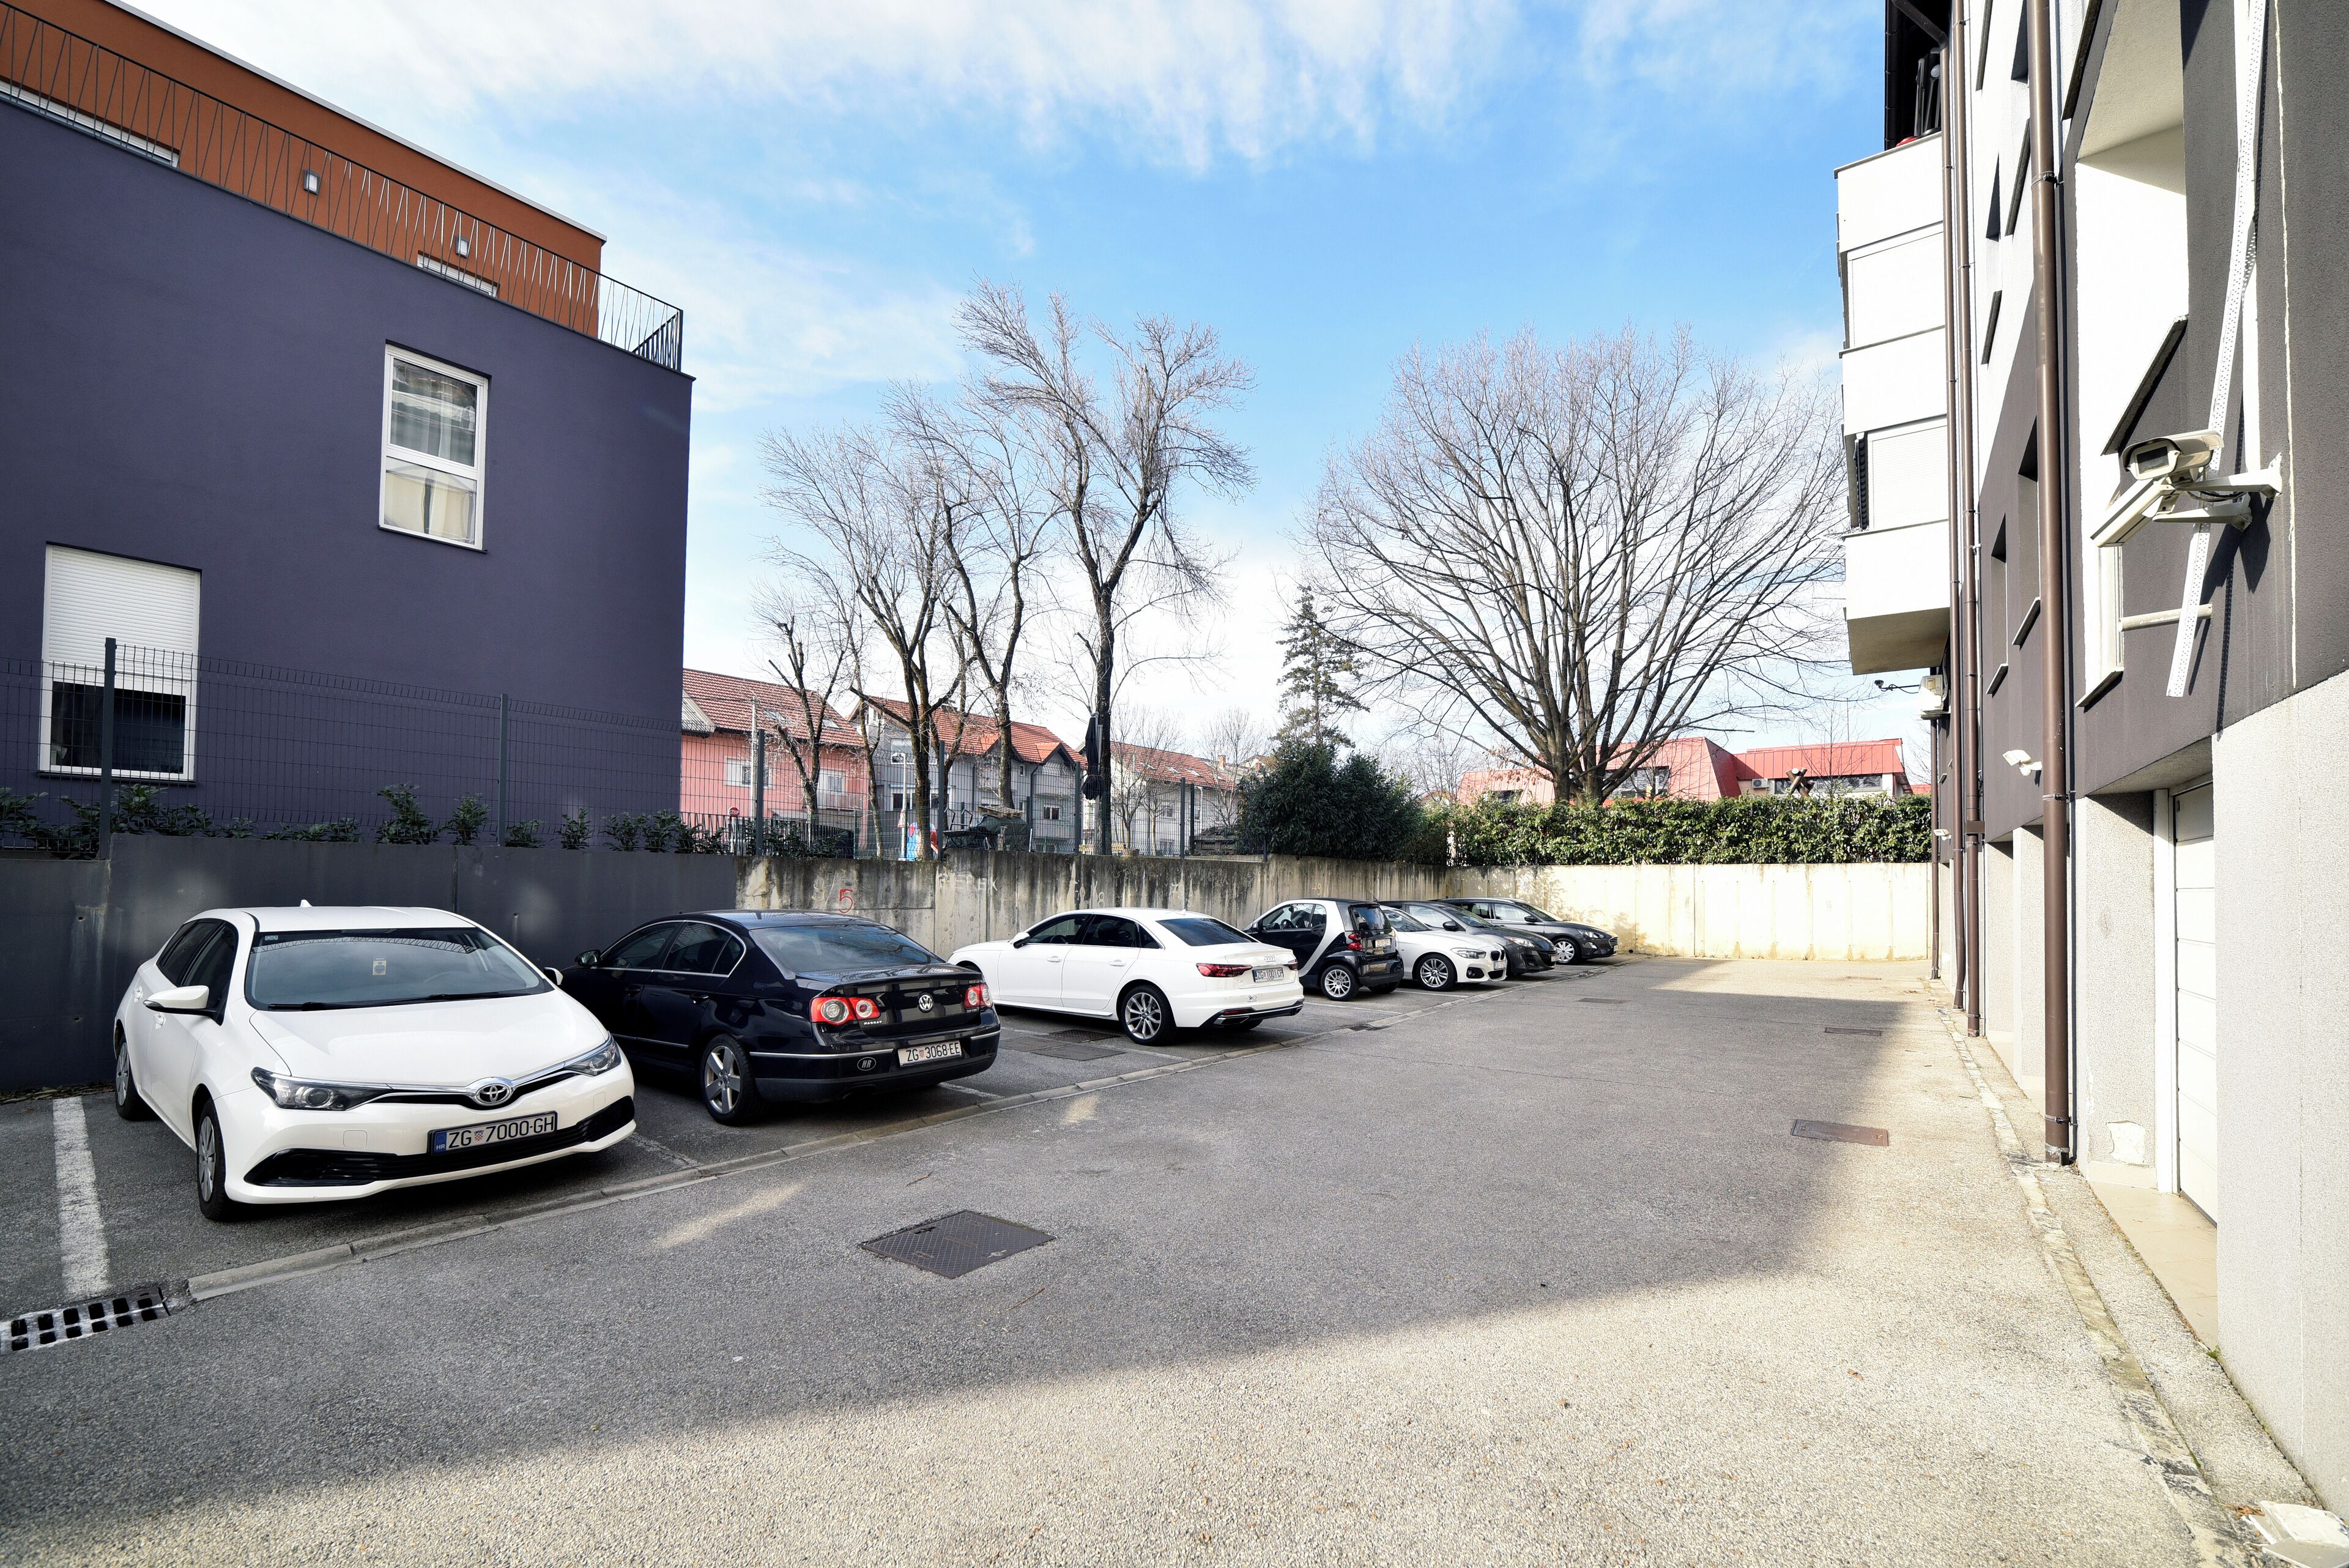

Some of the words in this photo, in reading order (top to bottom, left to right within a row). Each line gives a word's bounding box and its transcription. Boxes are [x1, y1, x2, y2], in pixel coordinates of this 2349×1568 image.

[838, 888, 854, 914] 5
[1257, 971, 1264, 979] ZG
[905, 1049, 919, 1062] ZG
[861, 1060, 872, 1069] HR
[448, 1130, 472, 1149] ZG
[485, 1116, 554, 1143] 7000-GH
